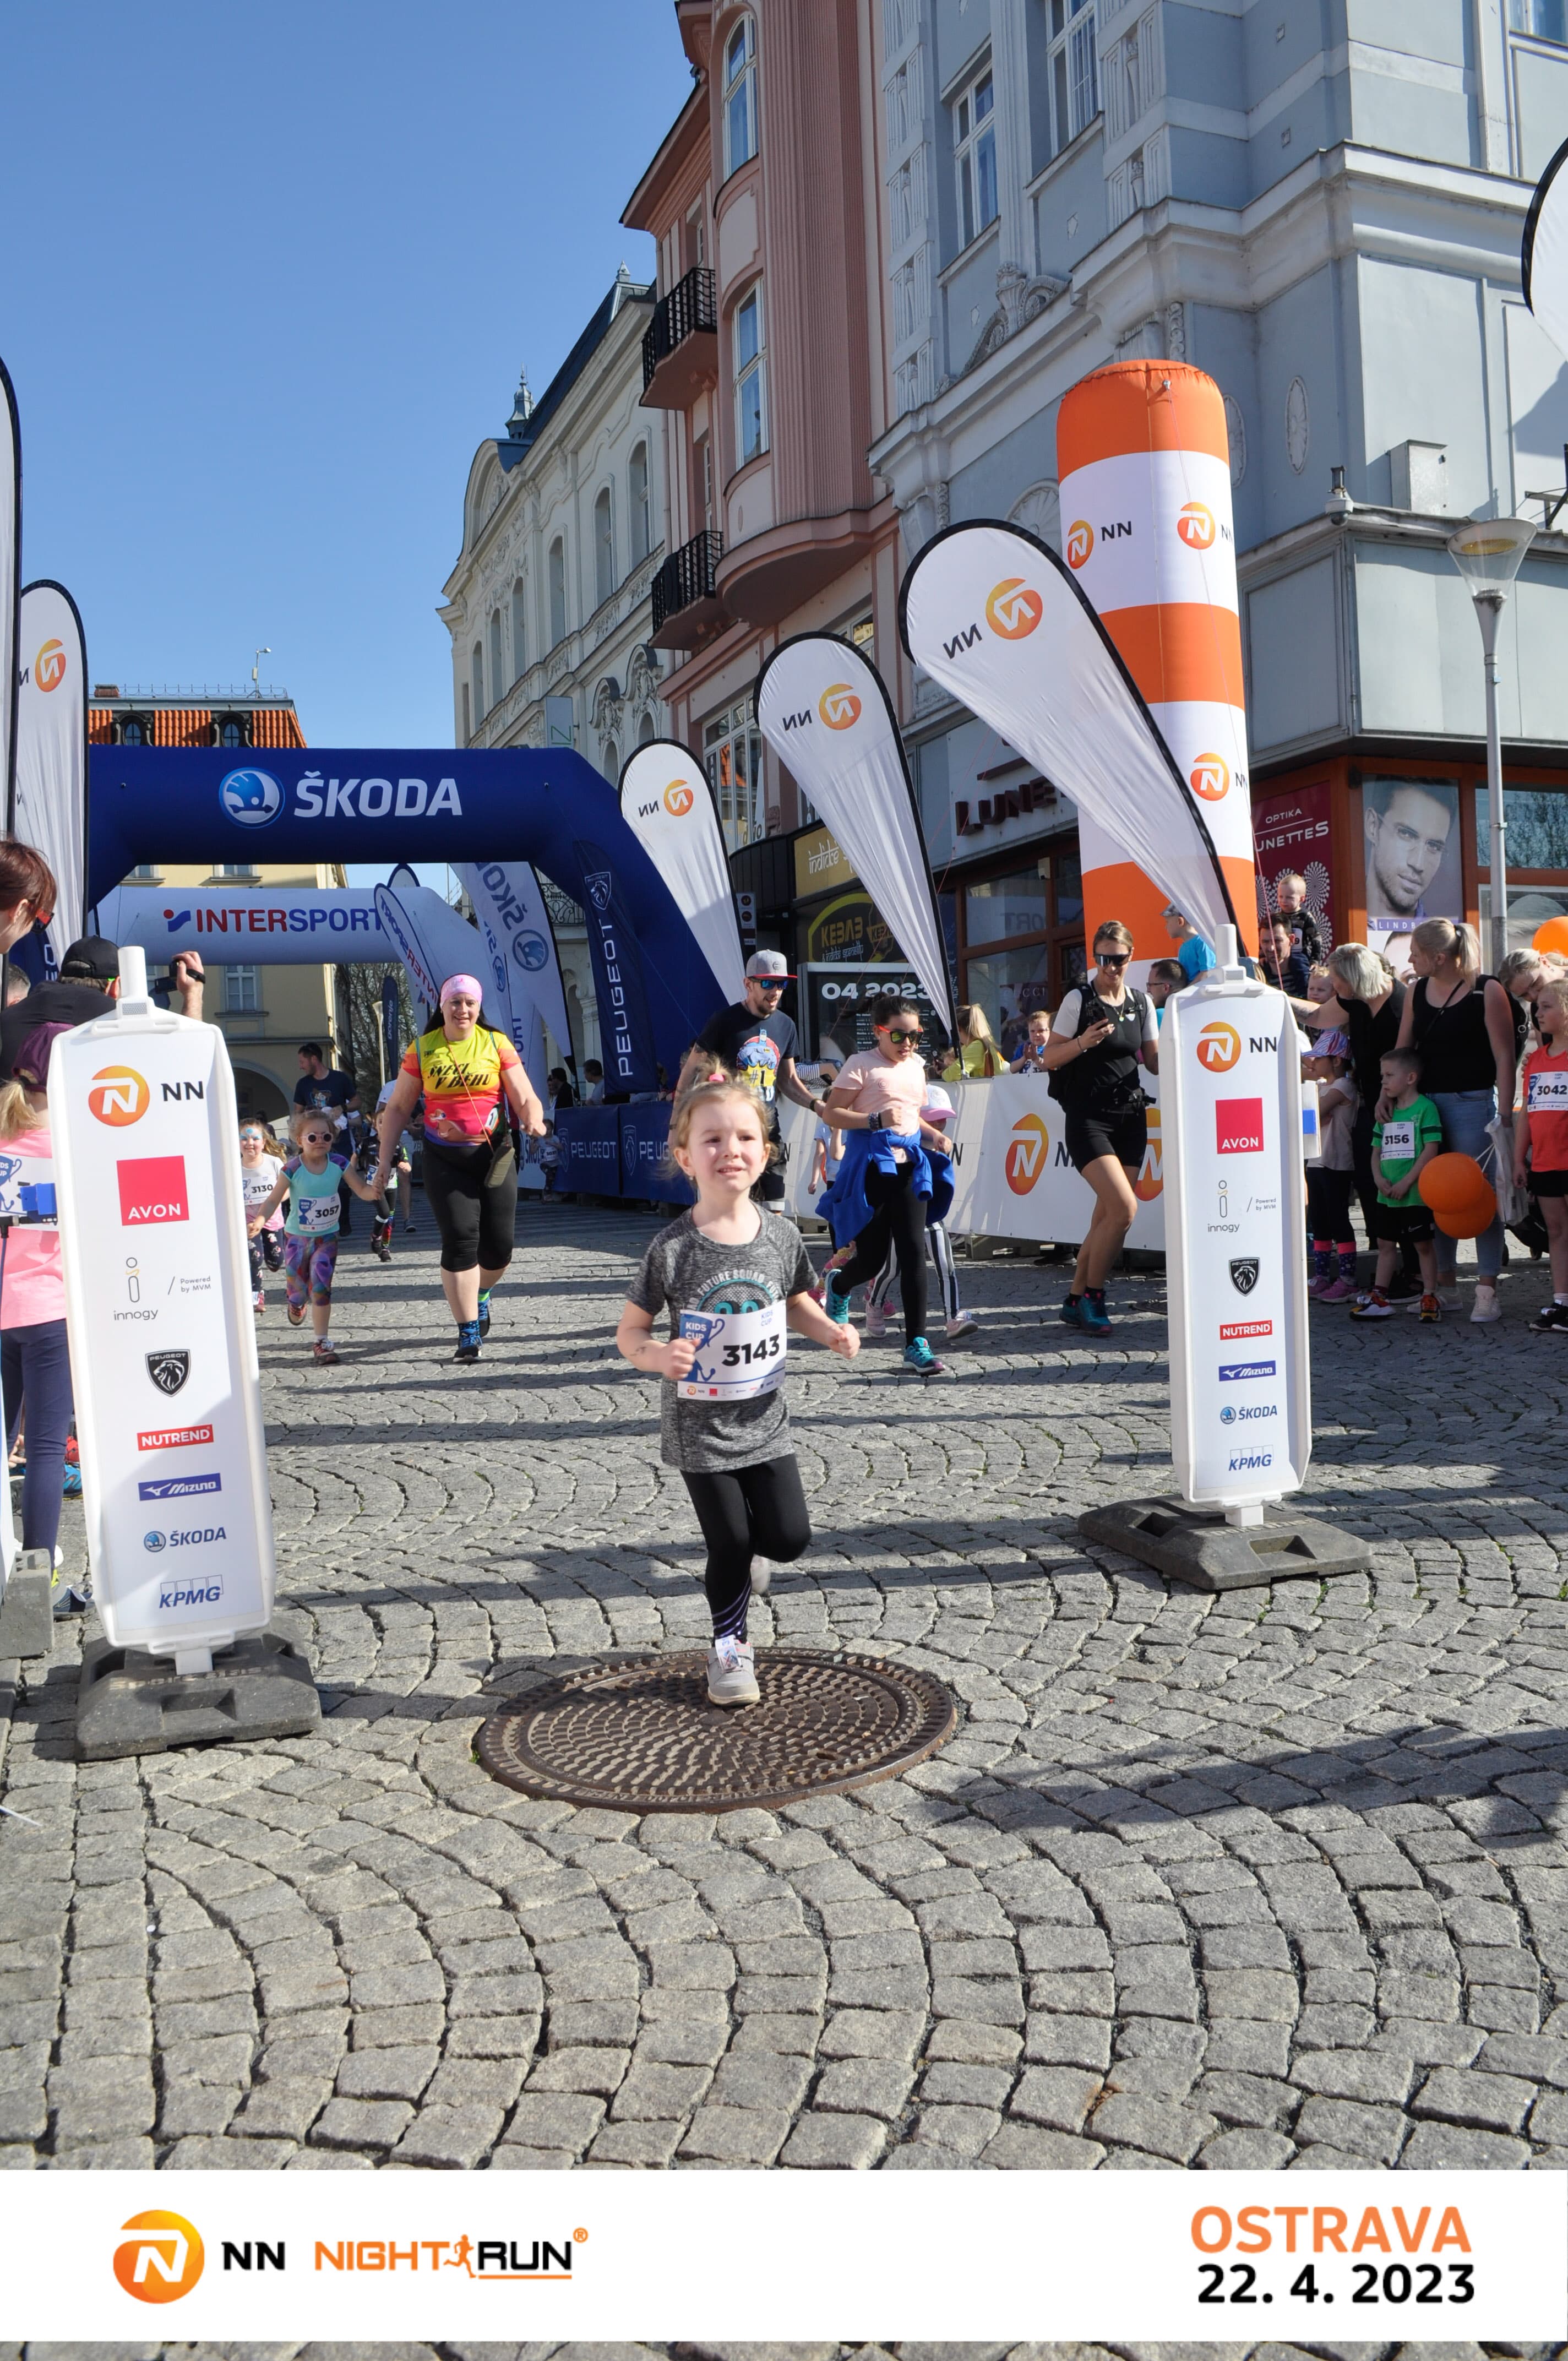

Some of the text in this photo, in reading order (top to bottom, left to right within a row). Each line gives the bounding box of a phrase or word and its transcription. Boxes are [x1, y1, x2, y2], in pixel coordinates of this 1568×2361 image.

[1101, 520, 1132, 542] NN
[293, 771, 462, 818] ŠKODA
[955, 776, 1068, 836] LUNE
[1265, 808, 1302, 824] OPTIKA
[1255, 820, 1329, 852] UNETTES
[195, 908, 382, 933] INTERSPORT
[598, 918, 634, 1076] PEUGEOT
[821, 982, 859, 1000] 04
[865, 982, 930, 1000] 2023
[1249, 1037, 1278, 1053] NN
[161, 1080, 204, 1102] NN
[1537, 1084, 1568, 1096] 3042
[1221, 1136, 1259, 1150] AVON
[1384, 1134, 1410, 1145] 3156
[571, 1141, 617, 1158] PEUGEOT
[639, 1141, 670, 1160] PEUG
[251, 1184, 273, 1194] 3130
[128, 1203, 181, 1220] AVON
[315, 1205, 339, 1218] 3057
[1207, 1223, 1240, 1233] innogy
[180, 1276, 212, 1285] Powered
[180, 1285, 190, 1293] by
[113, 1308, 159, 1321] innogy
[685, 1321, 707, 1332] KIDS
[1222, 1323, 1271, 1337] NUTREND
[685, 1331, 705, 1340] CUP
[149, 1352, 187, 1361] PEUGEOT
[721, 1334, 780, 1367] 3143
[1238, 1405, 1278, 1421] ŠKODA
[141, 1428, 211, 1448] NUTREND
[1228, 1454, 1272, 1472] KPMG
[170, 1527, 227, 1547] ŠKODA
[158, 1585, 221, 1608] KPMG
